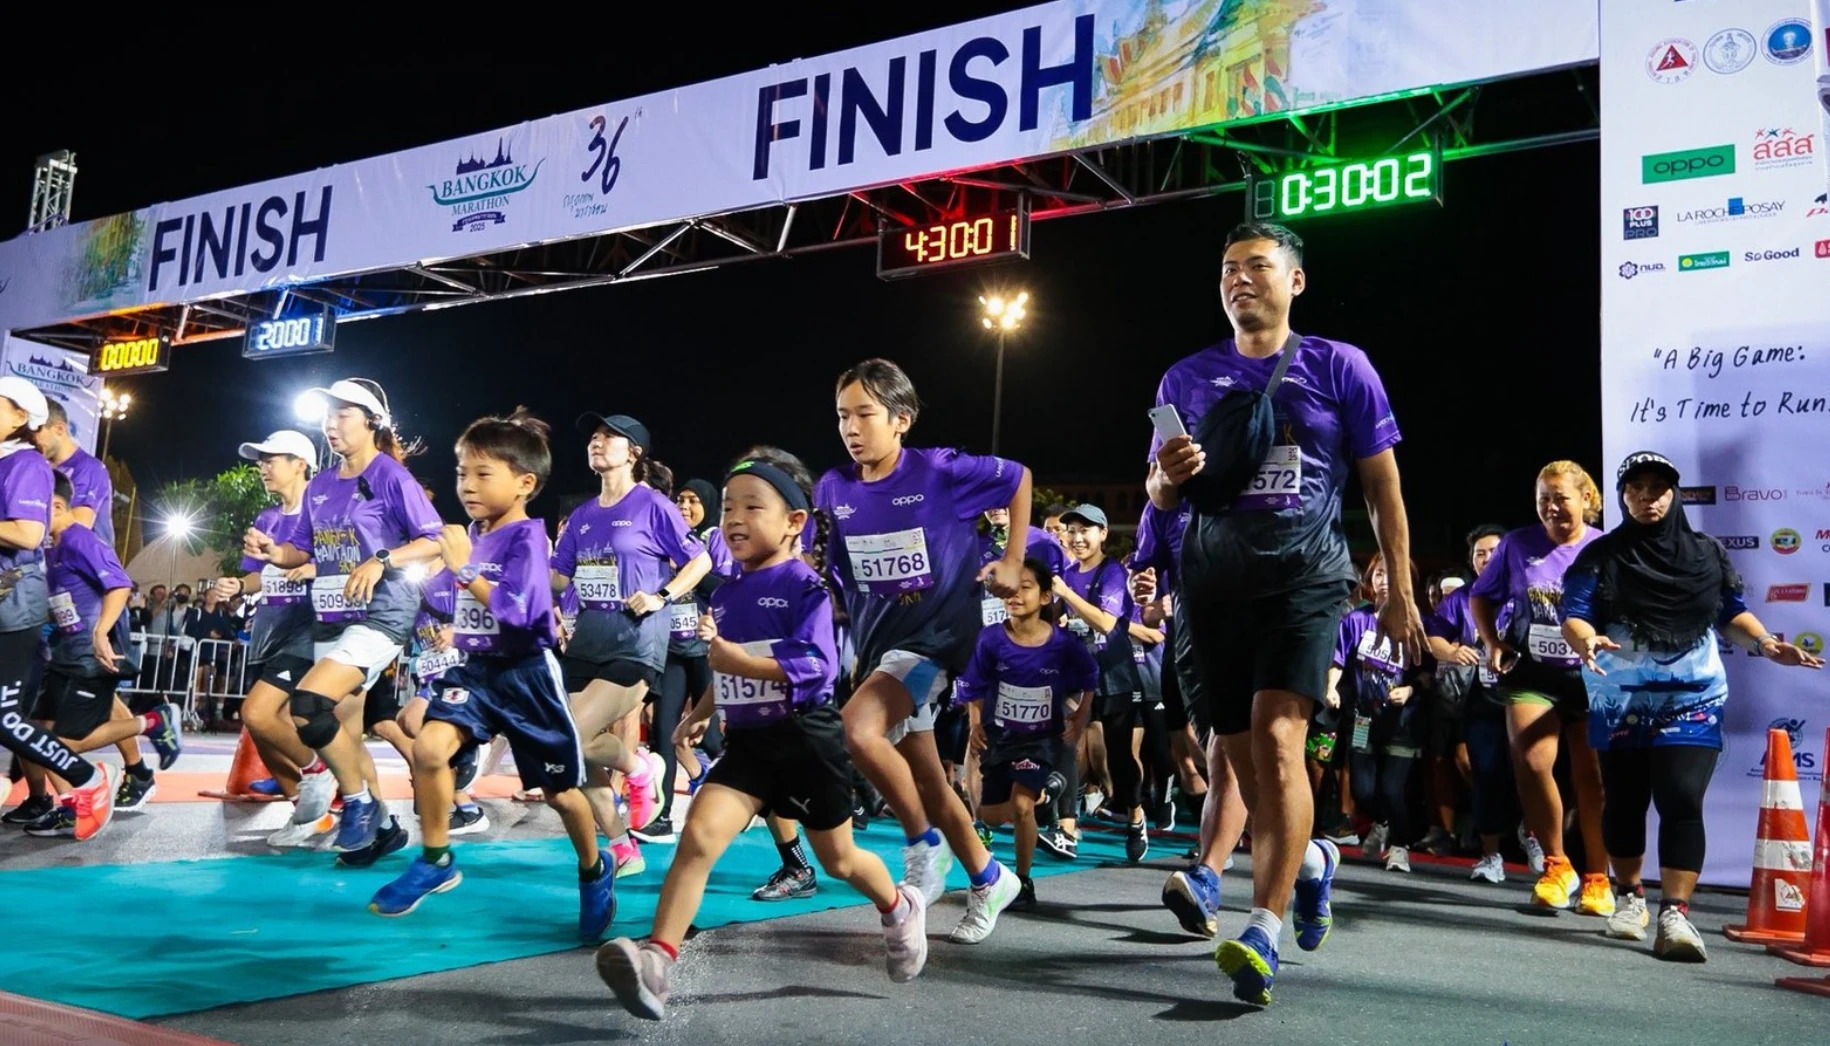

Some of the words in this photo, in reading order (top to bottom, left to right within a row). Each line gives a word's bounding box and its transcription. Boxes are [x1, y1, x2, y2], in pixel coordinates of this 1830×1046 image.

[752, 13, 1095, 180] FINISH
[1653, 155, 1724, 175] oppo
[442, 164, 527, 198] BANGKOK
[1282, 153, 1432, 216] 0:30:02
[451, 194, 509, 216] MARATHON
[1628, 207, 1654, 221] 100
[1629, 220, 1653, 228] PLUS
[1677, 212, 1694, 222] LA
[149, 185, 333, 292] FINISH
[905, 215, 1017, 262] 4:30:01
[1625, 228, 1657, 239] PRO
[1764, 248, 1800, 260] Good
[17, 362, 84, 384] BANGKOK
[1687, 346, 1724, 379] Big
[1733, 345, 1806, 368] Game:
[1631, 397, 1667, 423] It's
[1677, 398, 1731, 419] Time
[1741, 391, 1767, 418] to
[1253, 470, 1296, 490] 572
[893, 494, 924, 506] oppo
[1724, 486, 1783, 501] Bravo
[861, 552, 925, 577] 51768
[580, 584, 616, 598] 53478
[1539, 641, 1574, 655] 503
[0, 681, 22, 708] IT.
[1002, 701, 1049, 719] 51770
[2, 712, 35, 742] DO
[30, 734, 79, 770] JUST
